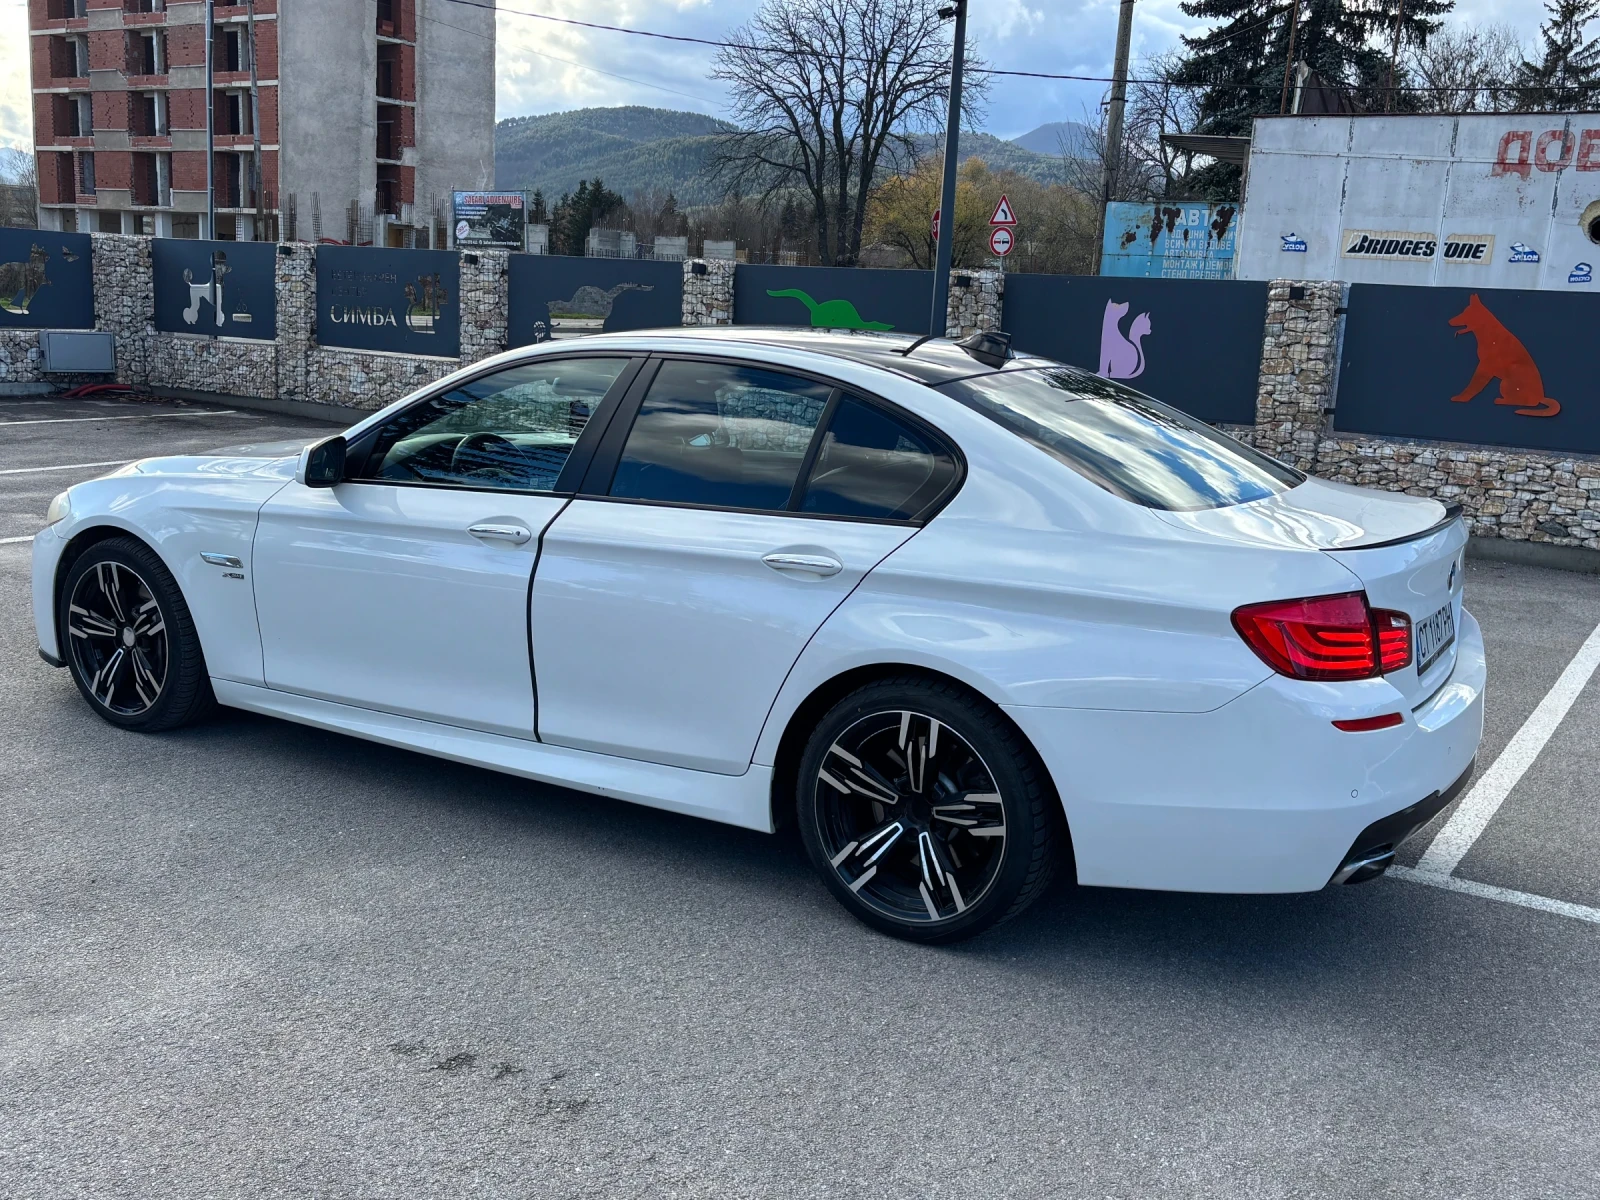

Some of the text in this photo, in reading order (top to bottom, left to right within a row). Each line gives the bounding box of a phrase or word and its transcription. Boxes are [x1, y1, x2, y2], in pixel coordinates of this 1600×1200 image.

[464, 195, 522, 205] SAFARI ADVENTURE
[1175, 209, 1238, 227] АВТС
[1165, 230, 1204, 239] ГОДШНИ
[1165, 240, 1197, 249] ВСИЧКИ
[1345, 235, 1487, 259] BRIDGESONE
[1162, 260, 1198, 270] МОНТАЖ
[1161, 270, 1187, 279] СТЕНД
[1189, 271, 1221, 280] ПРЕДЕН
[330, 304, 397, 327] СИМБА
